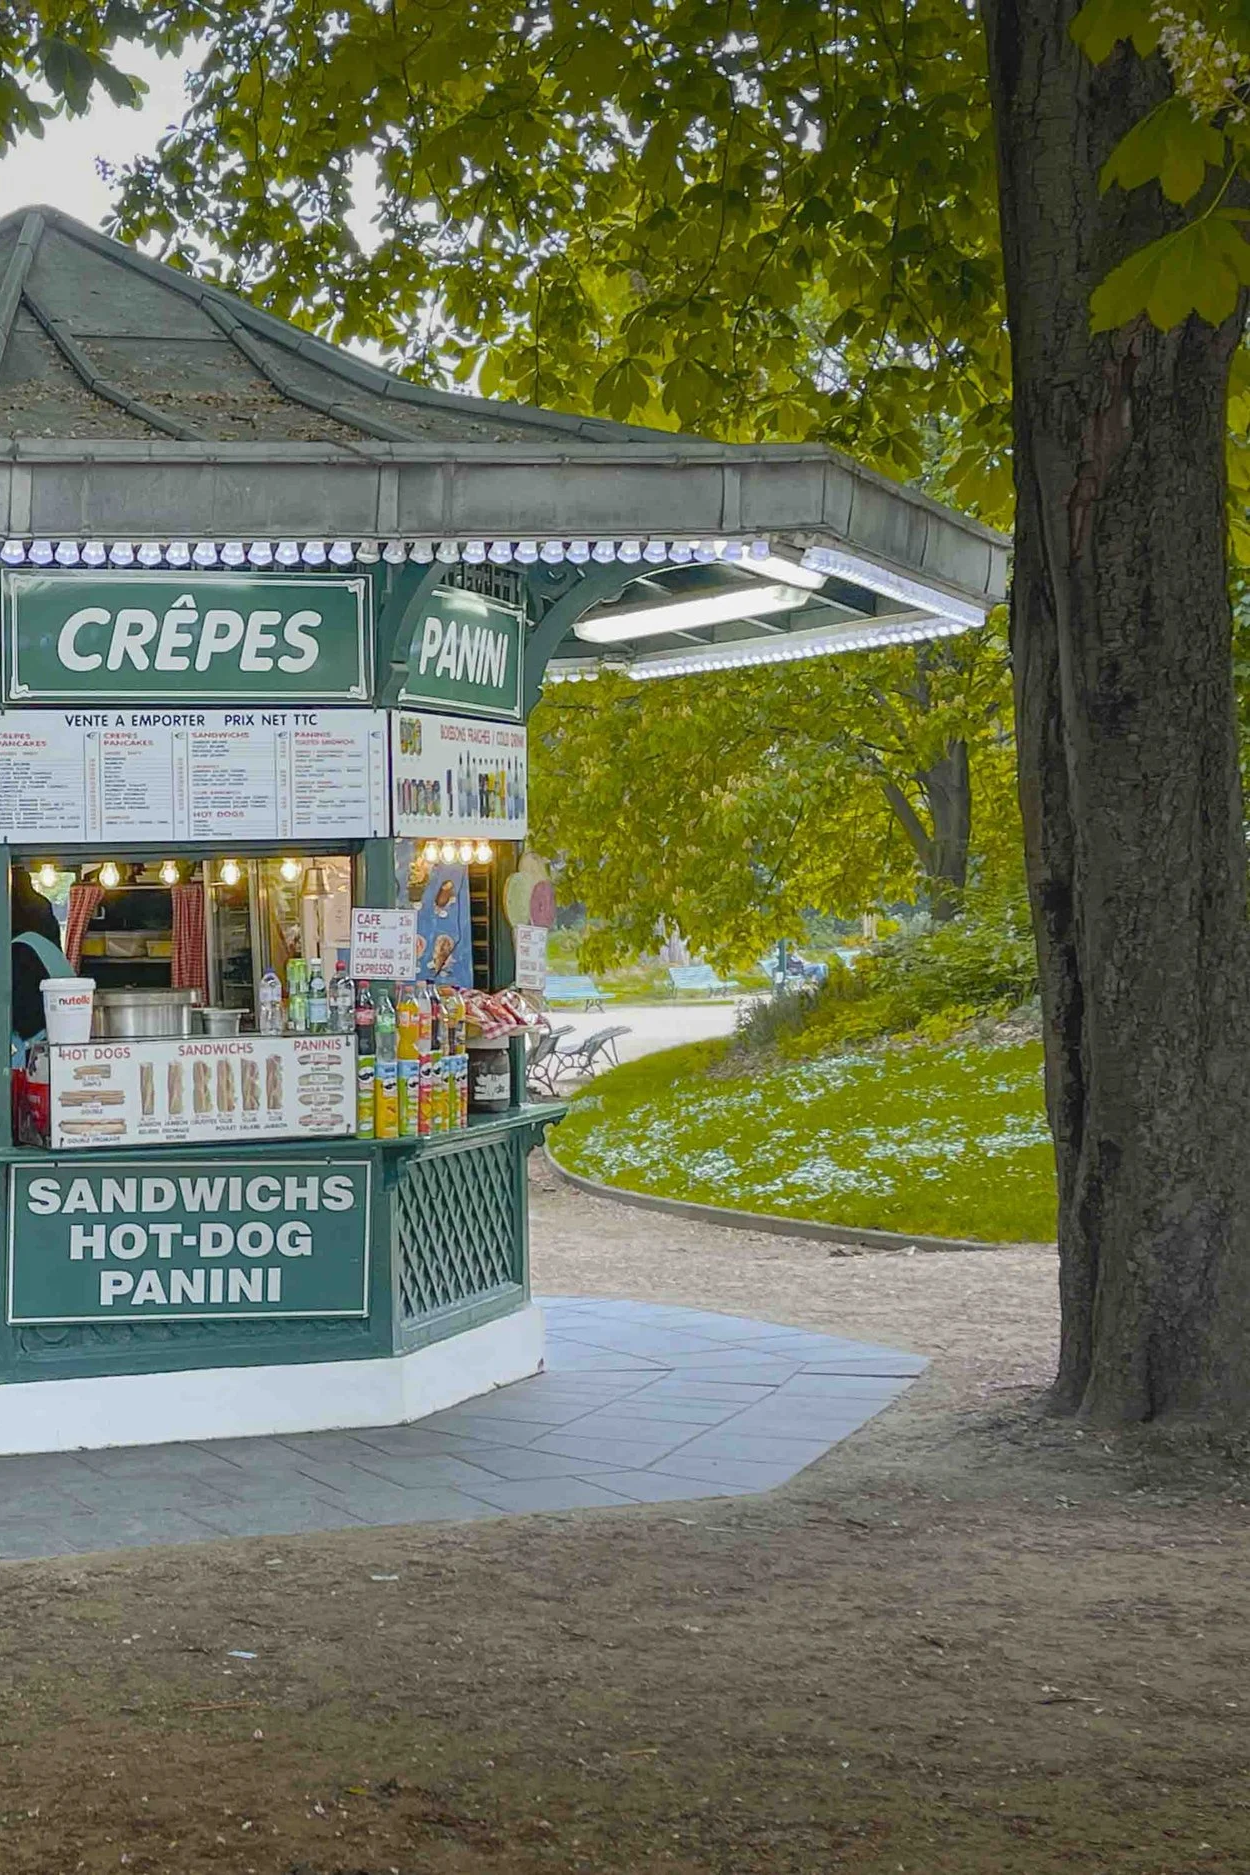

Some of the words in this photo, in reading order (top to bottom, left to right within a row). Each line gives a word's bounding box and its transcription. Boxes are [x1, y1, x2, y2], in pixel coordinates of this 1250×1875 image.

[57, 594, 322, 673] CRÊPES
[418, 616, 509, 689] PANINI
[64, 714, 110, 727] VENTE
[116, 714, 125, 727] A
[131, 714, 205, 727] EMPORTER
[224, 714, 255, 726] PRIX
[261, 714, 288, 726] NET
[293, 713, 318, 726] TTC
[357, 913, 382, 925] CAFE
[357, 932, 379, 943] THE
[355, 963, 394, 975] EXPRESSO
[178, 1042, 254, 1056] SANDWICHS
[294, 1038, 342, 1051] PANINIS
[62, 1049, 89, 1060] HOT
[94, 1046, 131, 1059] DOGS
[27, 1175, 354, 1214] SANDWICHS
[69, 1220, 312, 1260] HOT-DOG
[100, 1267, 281, 1305] PANINI
